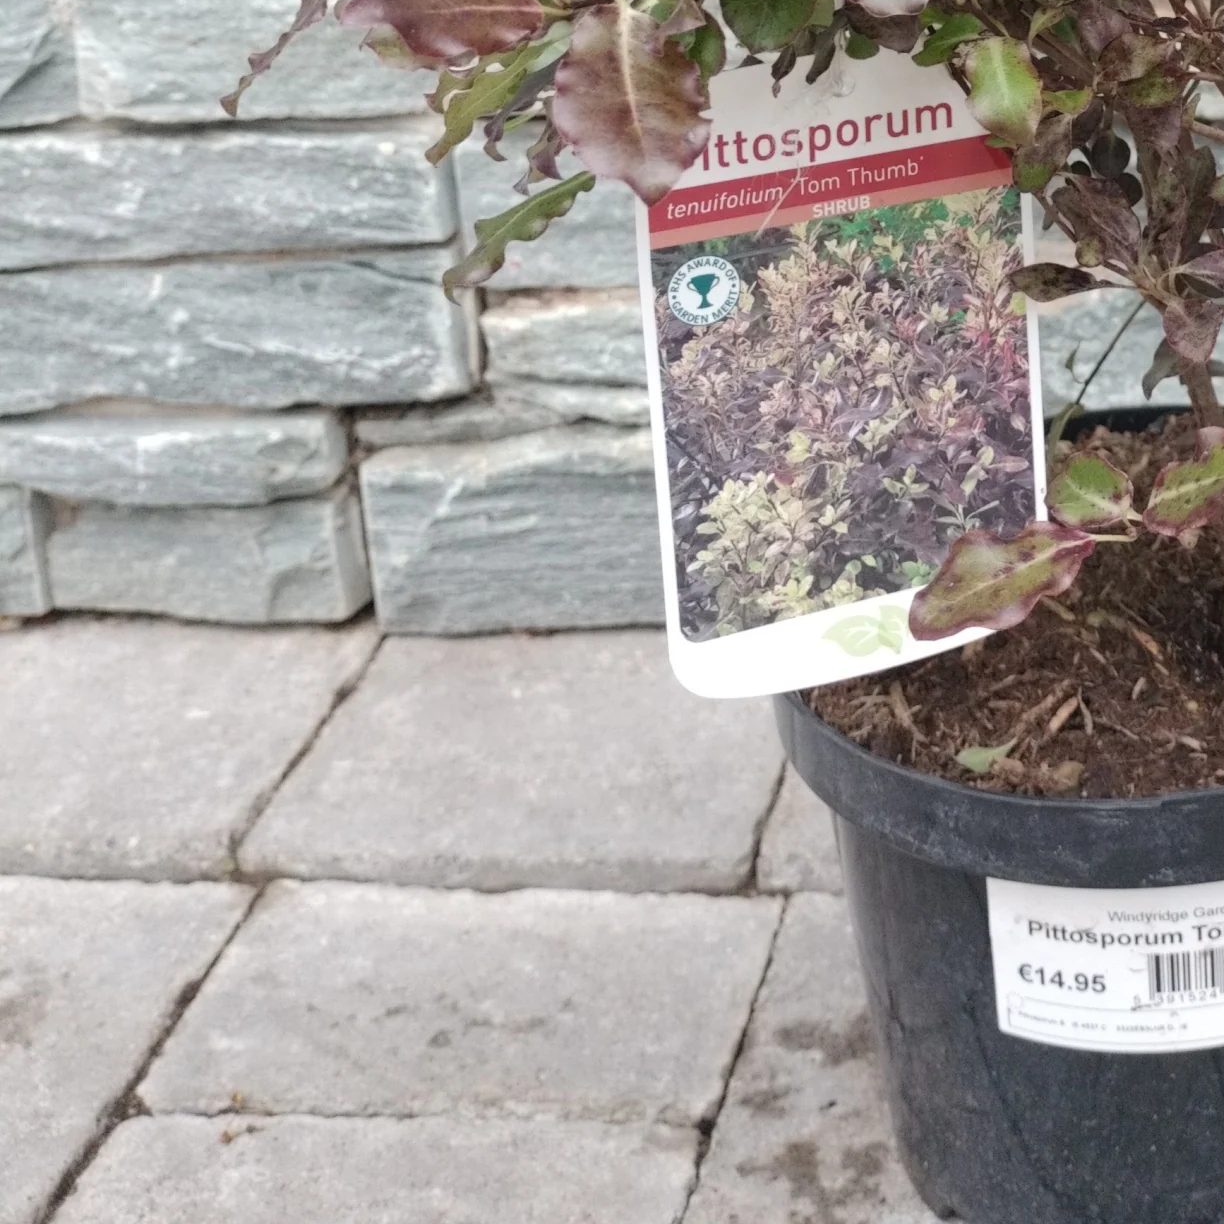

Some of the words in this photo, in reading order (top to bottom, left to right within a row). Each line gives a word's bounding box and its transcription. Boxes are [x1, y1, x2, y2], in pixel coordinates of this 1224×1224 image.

[702, 102, 953, 171] ittosporum
[667, 187, 783, 220] tenuifolium
[812, 195, 871, 218] SHRUB
[670, 271, 686, 293] RHS
[686, 258, 728, 272] AWARD
[725, 268, 738, 285] OF
[672, 301, 709, 324] GARDEN
[712, 289, 738, 320] MERIT
[1108, 909, 1189, 924] Windyridge
[1027, 918, 1184, 950] Pittosporum
[1018, 963, 1107, 994] €14.95
